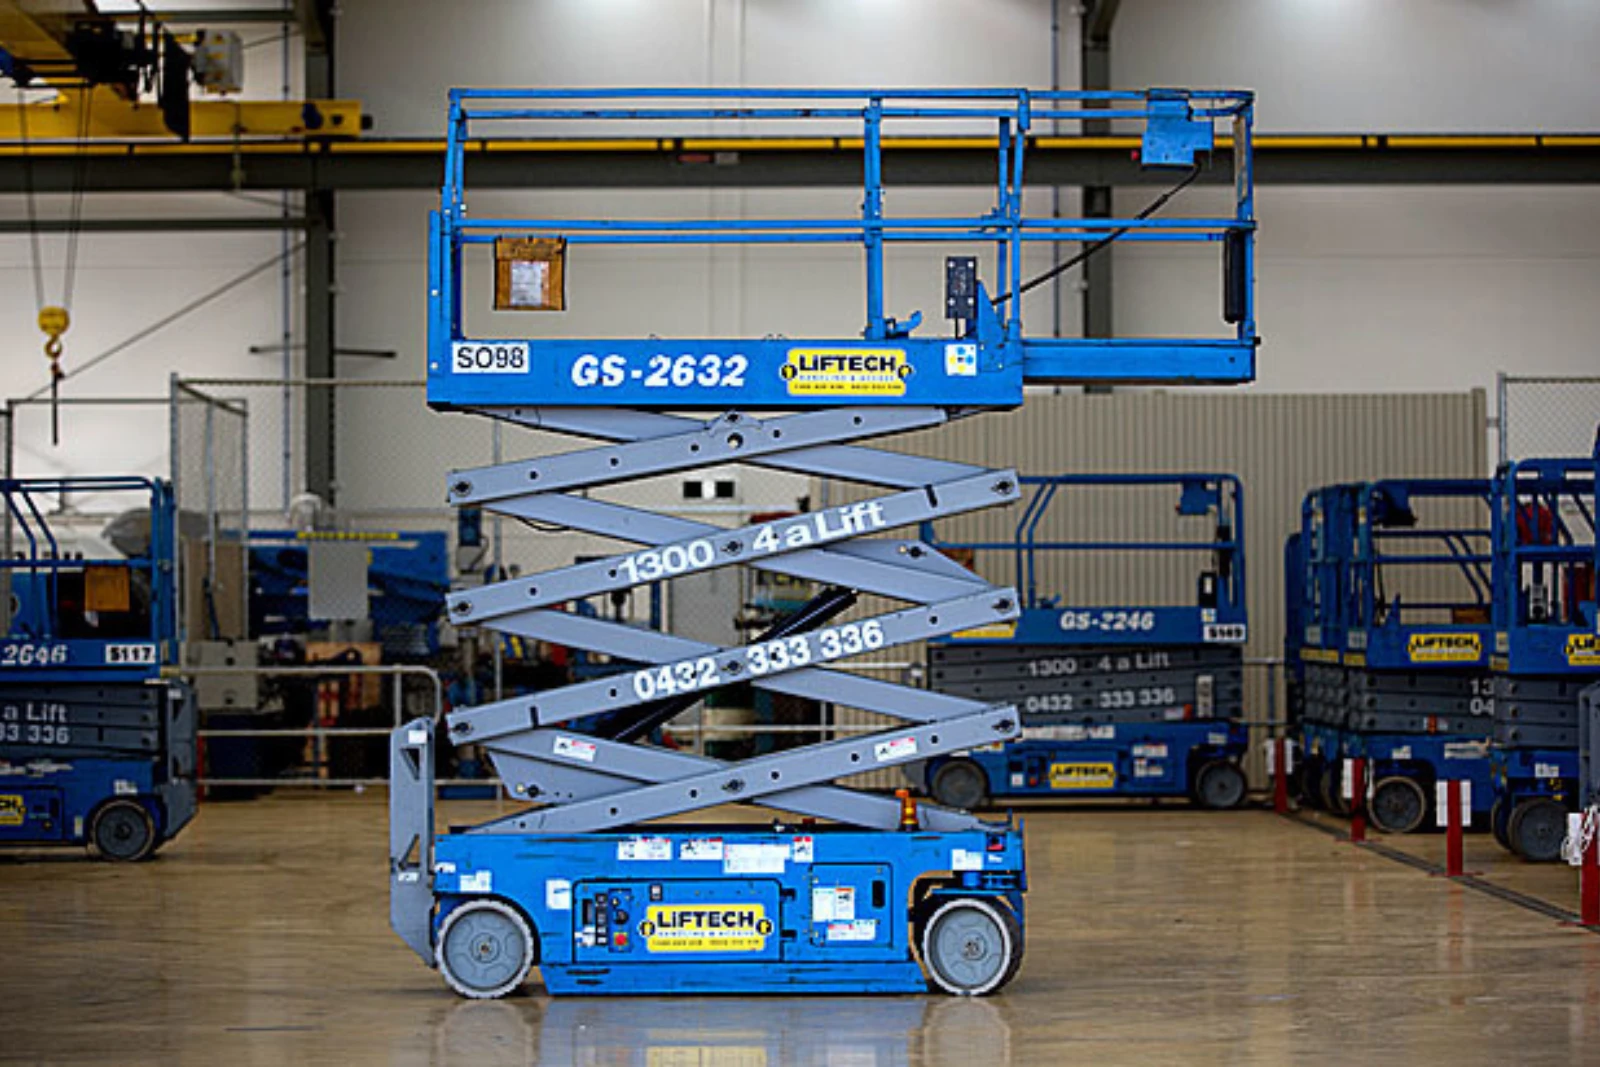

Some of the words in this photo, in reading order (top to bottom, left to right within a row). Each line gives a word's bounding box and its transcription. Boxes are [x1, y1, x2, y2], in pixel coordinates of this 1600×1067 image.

[571, 353, 748, 387] GS-2632
[618, 540, 714, 583] 1300
[633, 658, 720, 699] 0432
[746, 637, 811, 674] 333
[820, 620, 883, 659] 336
[1029, 658, 1078, 677] 1300
[1099, 655, 1112, 671] 4
[1135, 652, 1170, 670] Lift
[26, 702, 68, 722] Lift
[1026, 693, 1073, 712] 0432
[1100, 690, 1135, 708] 333
[1139, 687, 1174, 705] 336
[28, 725, 70, 744] 336
